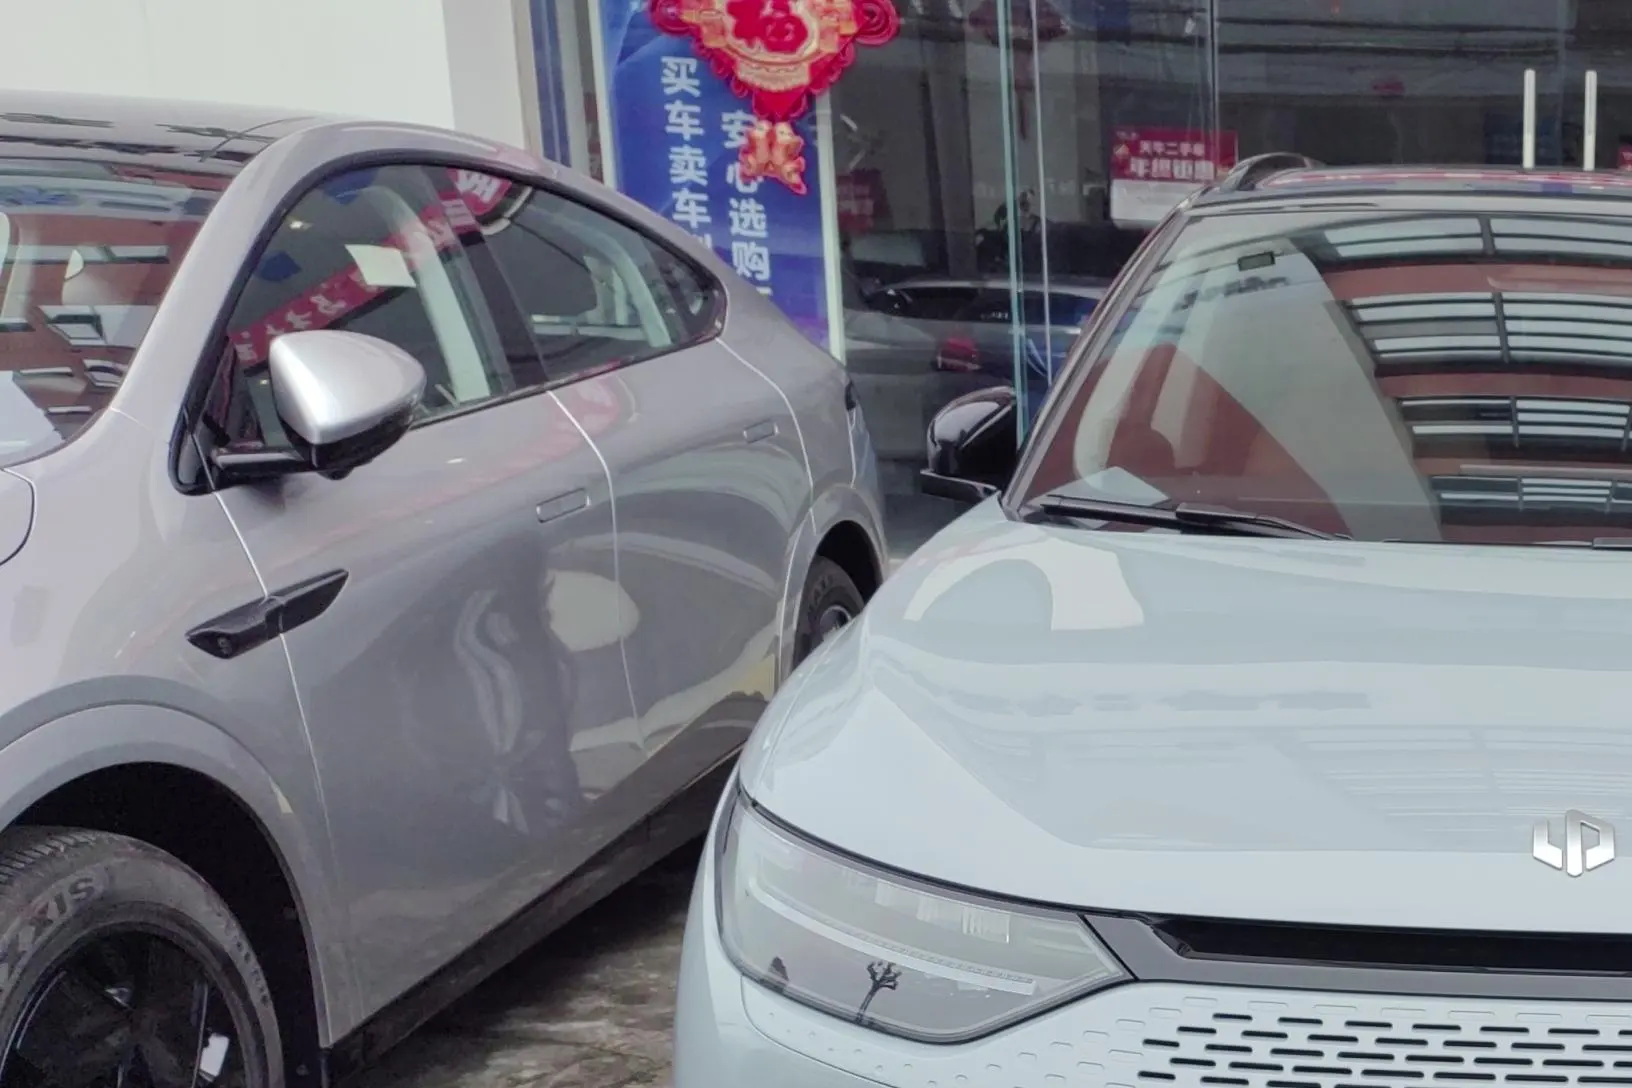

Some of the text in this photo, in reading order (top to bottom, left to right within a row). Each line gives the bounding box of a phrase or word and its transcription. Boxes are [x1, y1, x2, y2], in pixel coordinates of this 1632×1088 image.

[661, 56, 712, 249] 买车卖车
[721, 110, 773, 296] 安心选购
